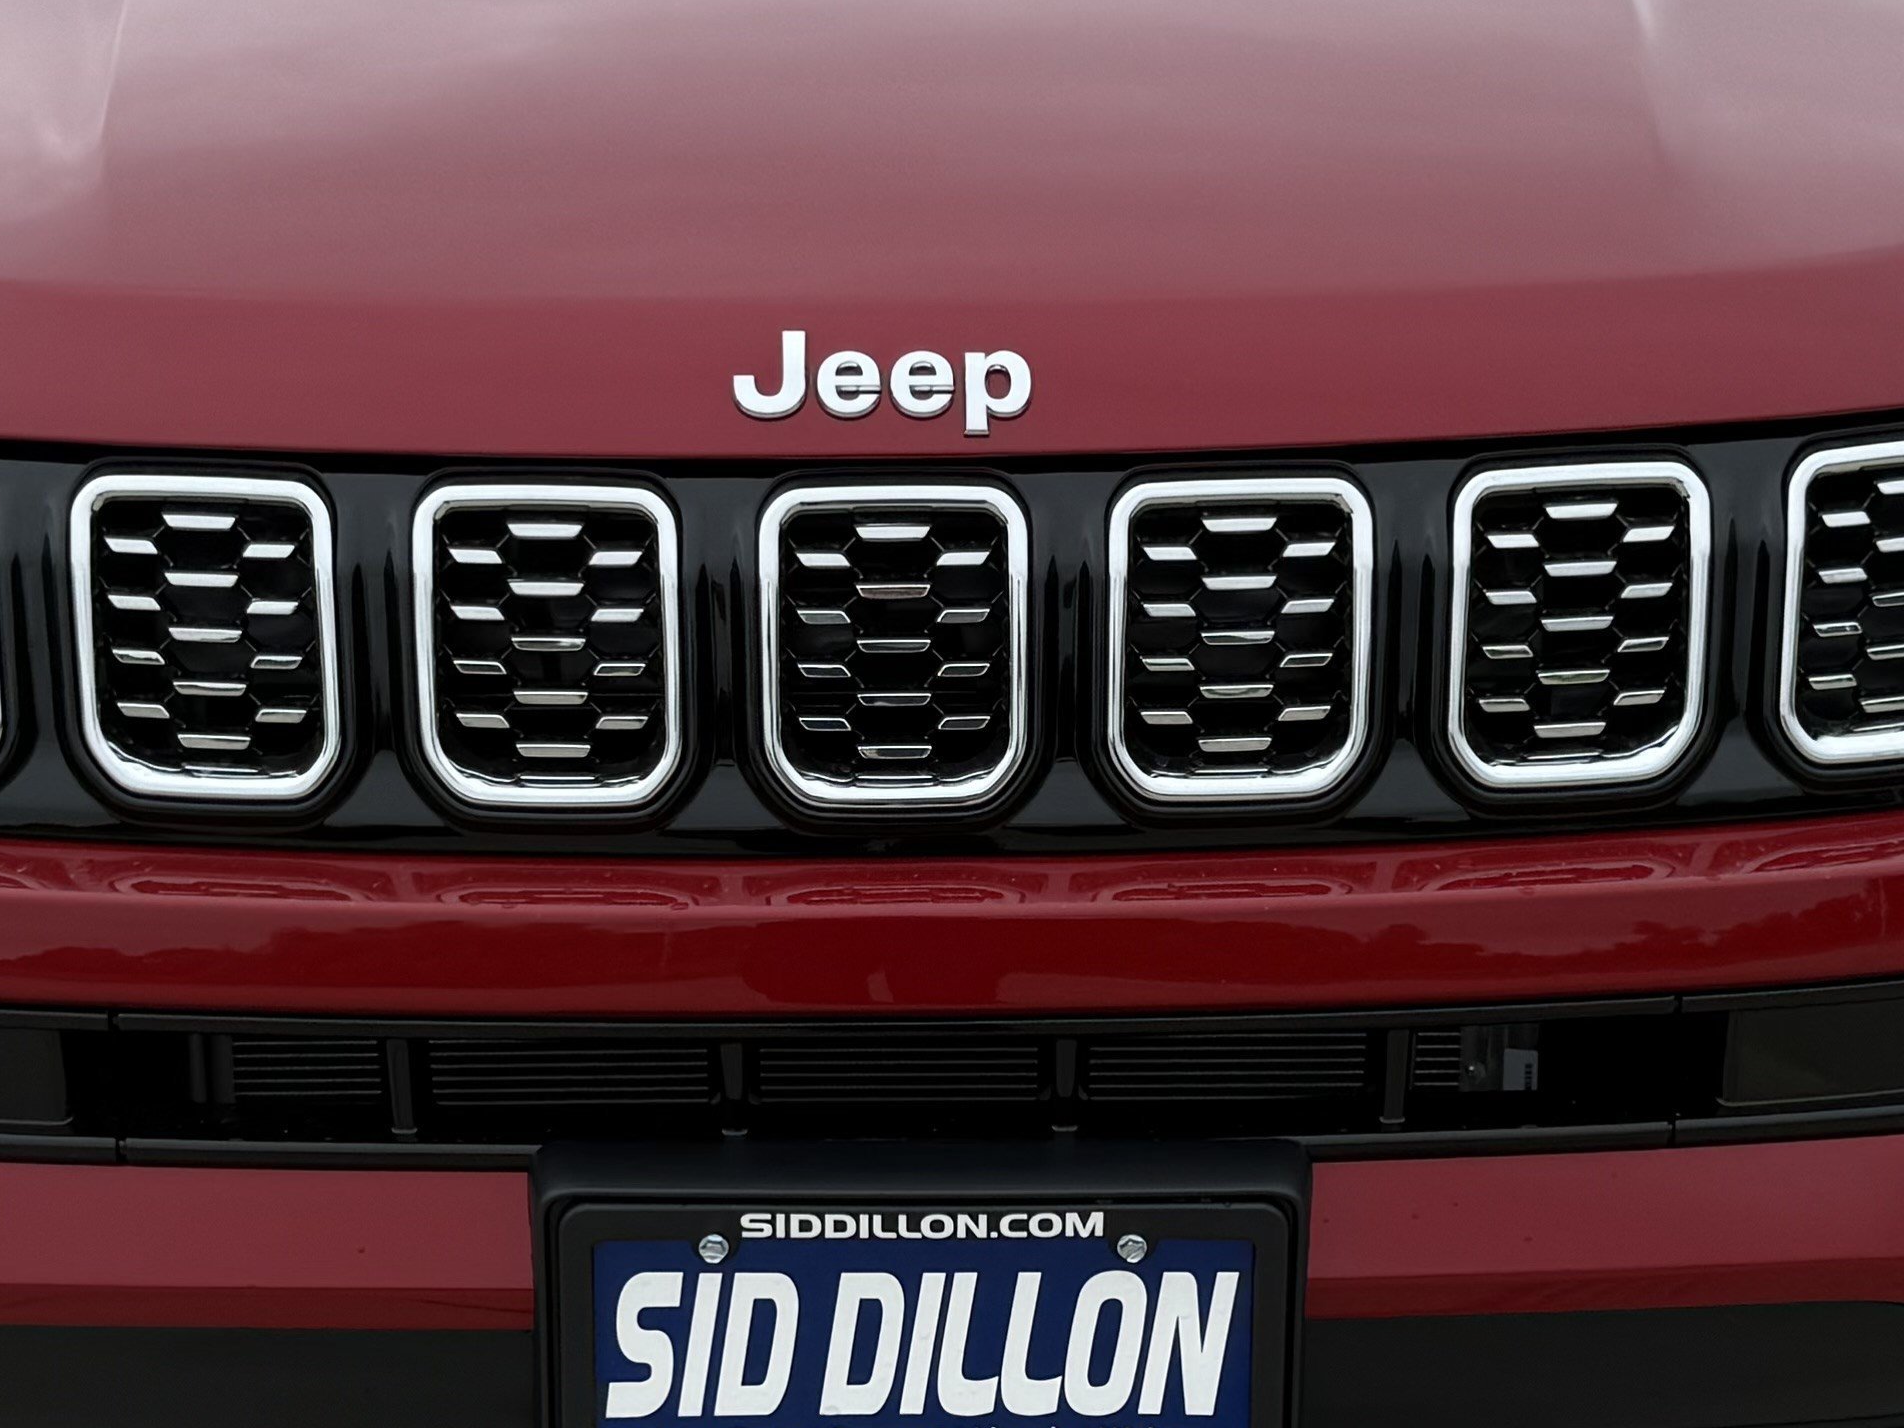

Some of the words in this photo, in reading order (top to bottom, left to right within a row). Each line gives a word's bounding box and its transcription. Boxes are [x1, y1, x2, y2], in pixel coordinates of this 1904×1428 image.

[732, 329, 1033, 437] Jeep
[740, 1211, 1105, 1239] SIDDILLON.COM
[605, 1270, 800, 1419] SID
[819, 1270, 1241, 1418] DILLON
